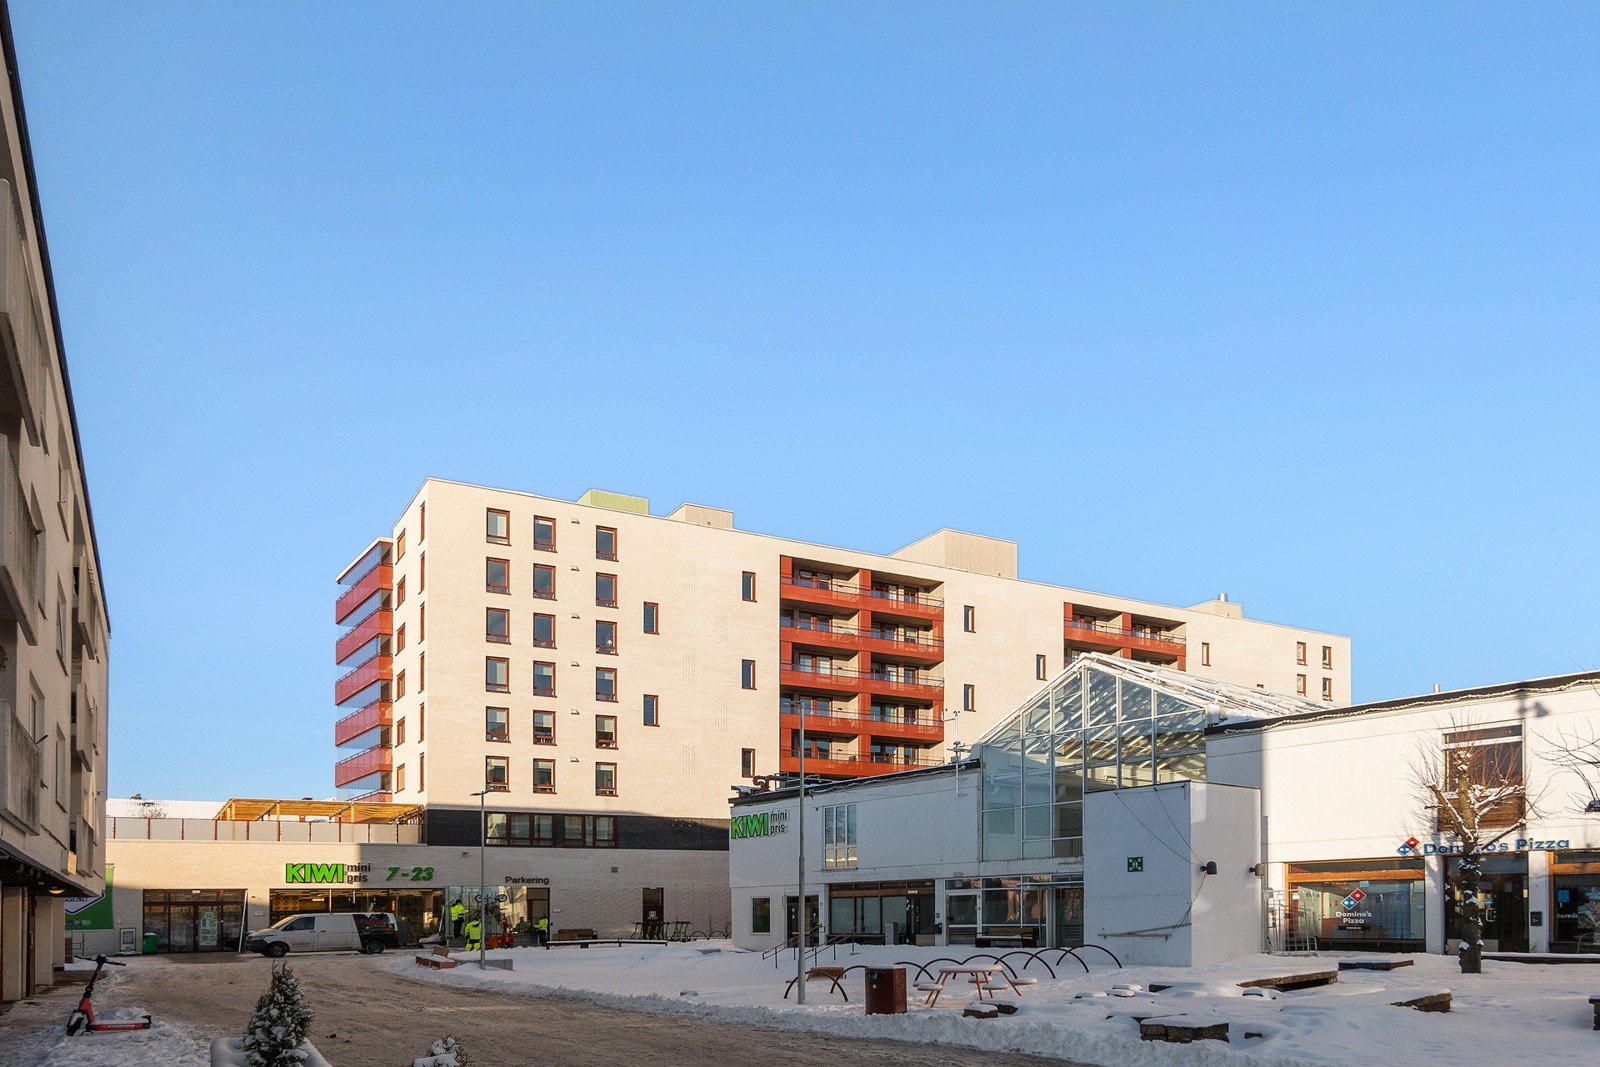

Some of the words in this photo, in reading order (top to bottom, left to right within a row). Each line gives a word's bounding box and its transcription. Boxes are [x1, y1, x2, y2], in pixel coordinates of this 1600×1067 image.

[771, 809, 788, 822] mini
[731, 812, 769, 839] KIWI
[771, 822, 787, 835] pris
[1423, 839, 1509, 855] Domo's
[1516, 837, 1569, 850] Pizza
[286, 863, 344, 883] KIWI
[347, 863, 371, 872] mini
[386, 867, 434, 881] 7-23
[347, 873, 368, 884] pris
[505, 876, 550, 885] Parkering
